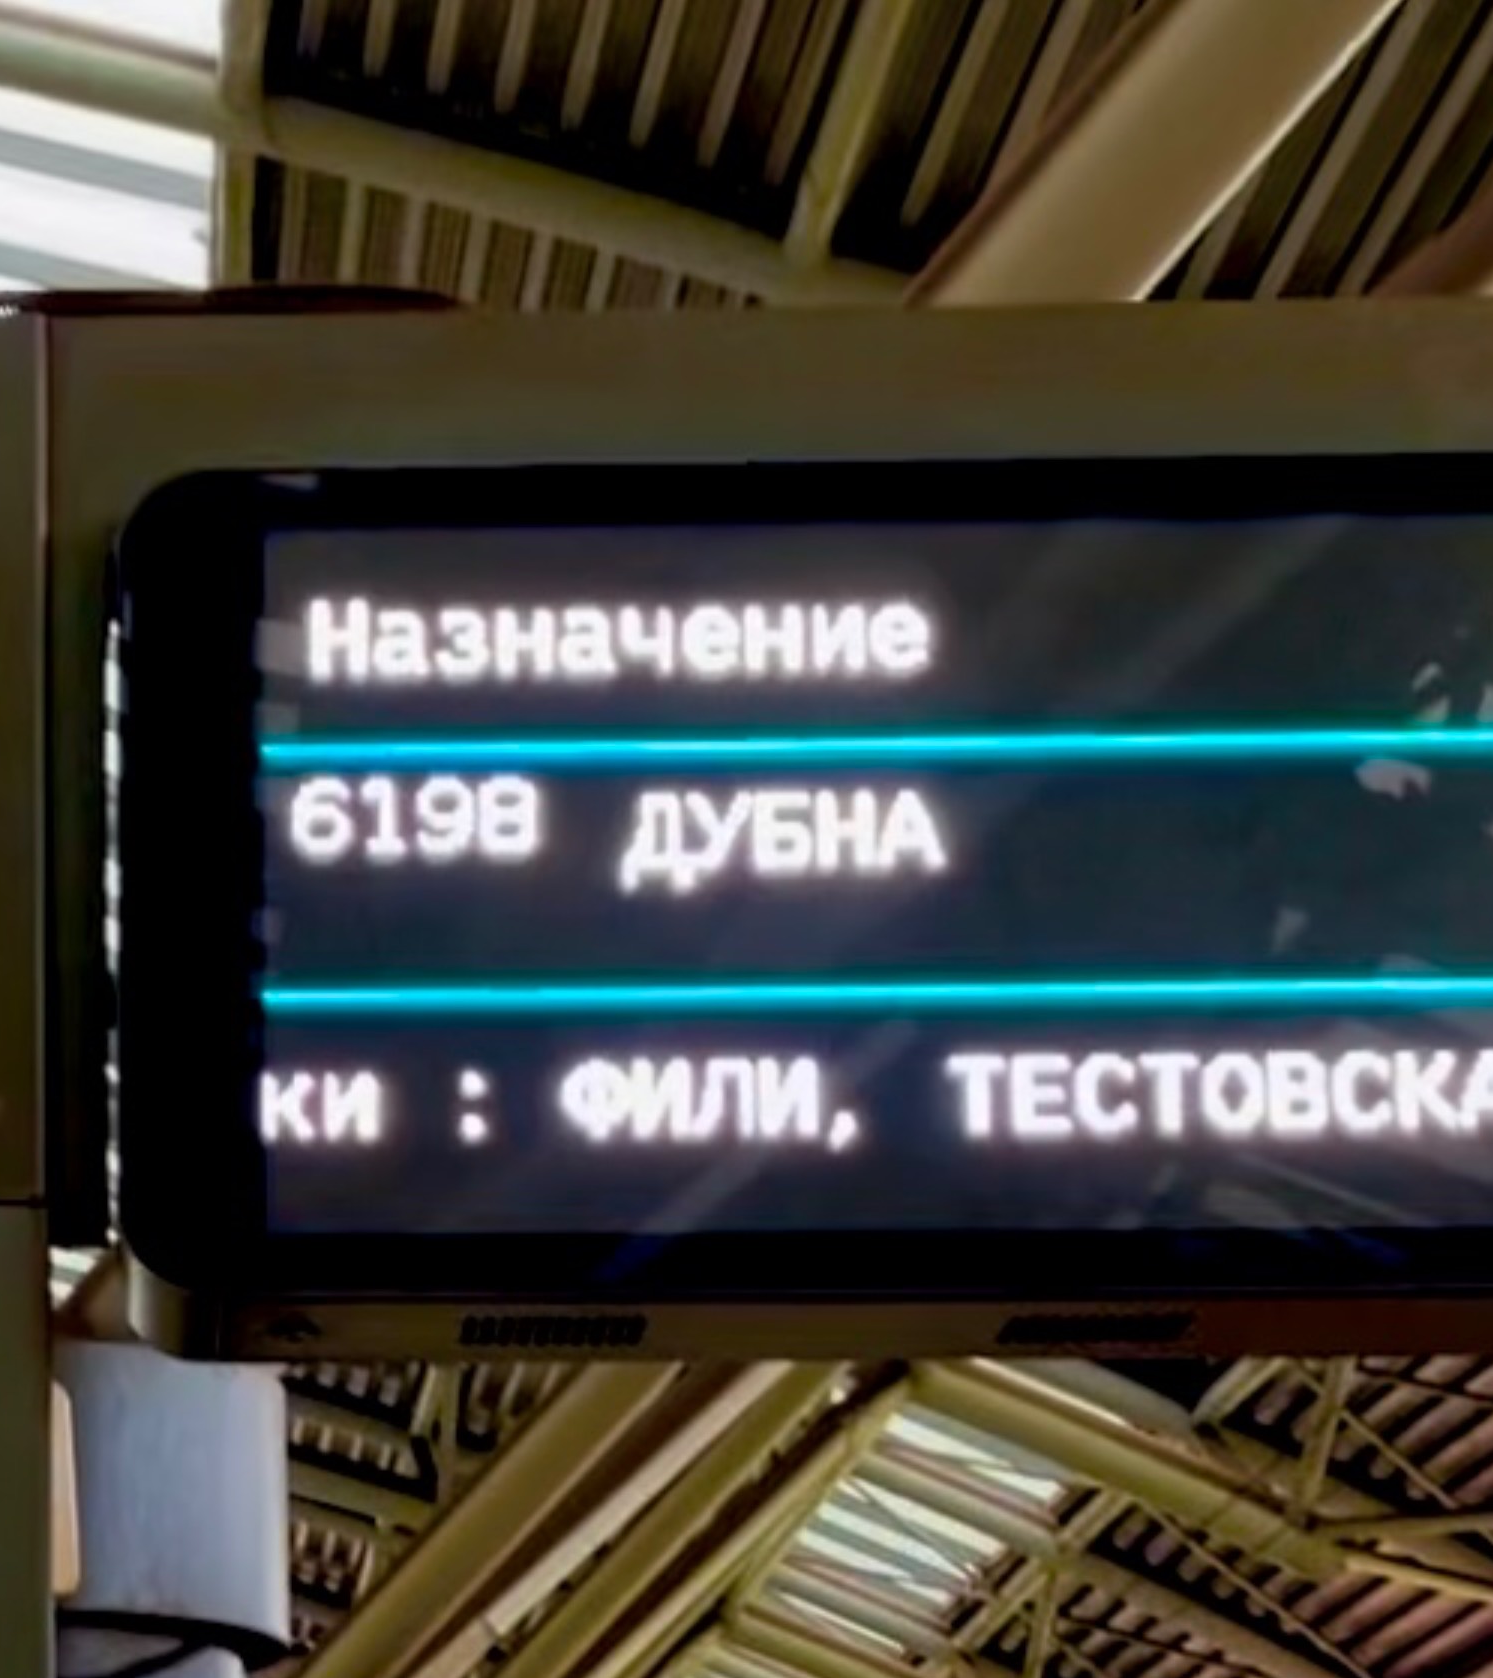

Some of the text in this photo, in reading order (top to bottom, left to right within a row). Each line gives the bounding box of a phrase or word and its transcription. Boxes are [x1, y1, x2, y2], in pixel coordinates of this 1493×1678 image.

[306, 596, 932, 682] Назначение
[289, 775, 541, 859] 6198
[619, 787, 948, 893] ДУБНА
[260, 1070, 383, 1142] ки
[460, 1070, 488, 1141] :
[558, 1055, 858, 1150] ФИЛИ,
